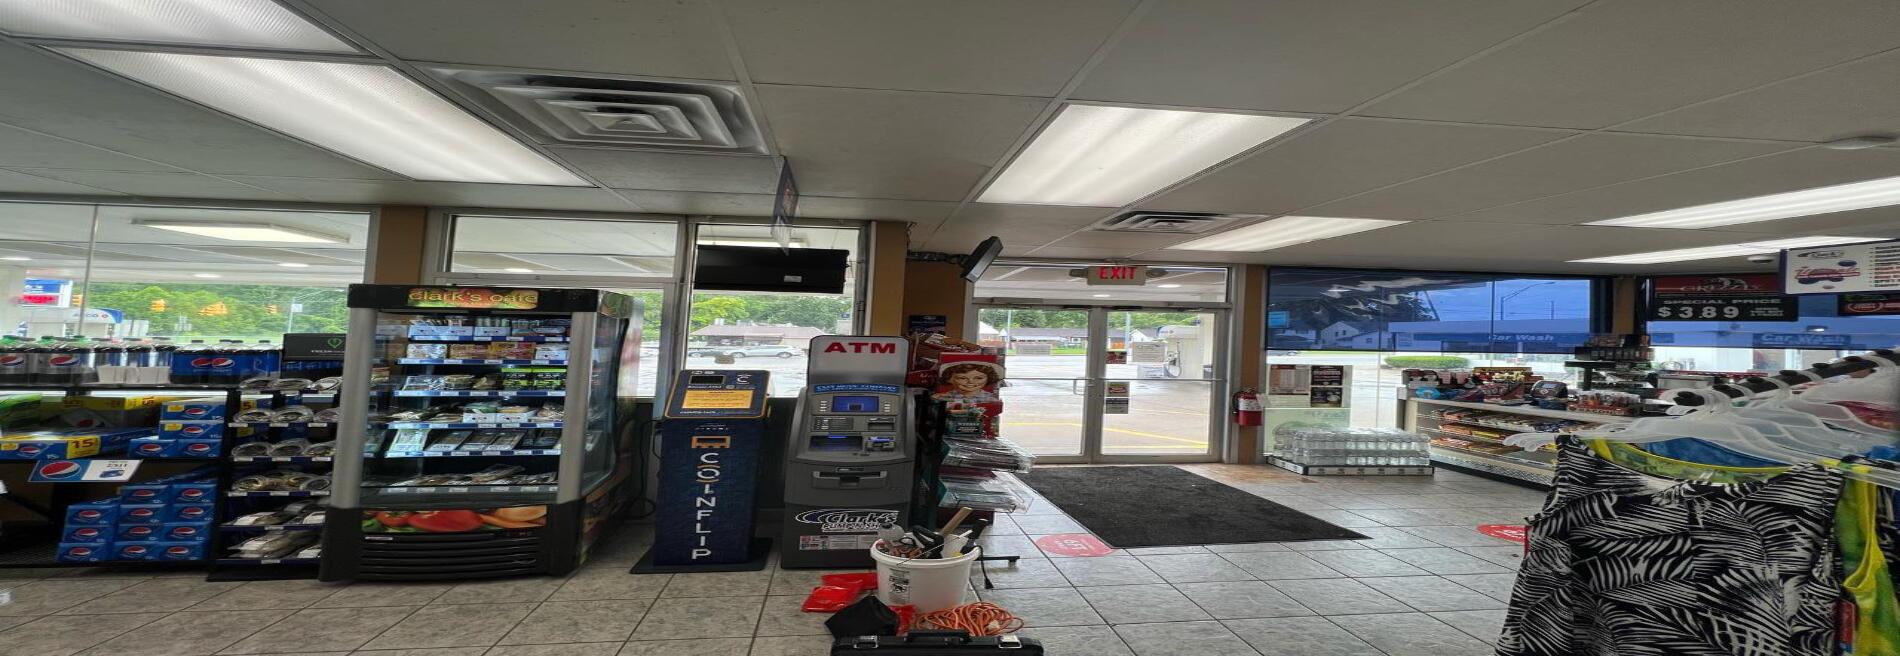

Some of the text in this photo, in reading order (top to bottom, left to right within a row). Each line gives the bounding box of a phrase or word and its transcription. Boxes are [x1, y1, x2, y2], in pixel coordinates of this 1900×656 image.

[1098, 266, 1137, 280] EXIT
[1761, 333, 1845, 343] Car Wash
[824, 342, 896, 353] ATM
[72, 439, 93, 449] 15
[692, 452, 720, 560] COINFLIP
[818, 510, 898, 524] Clark's
